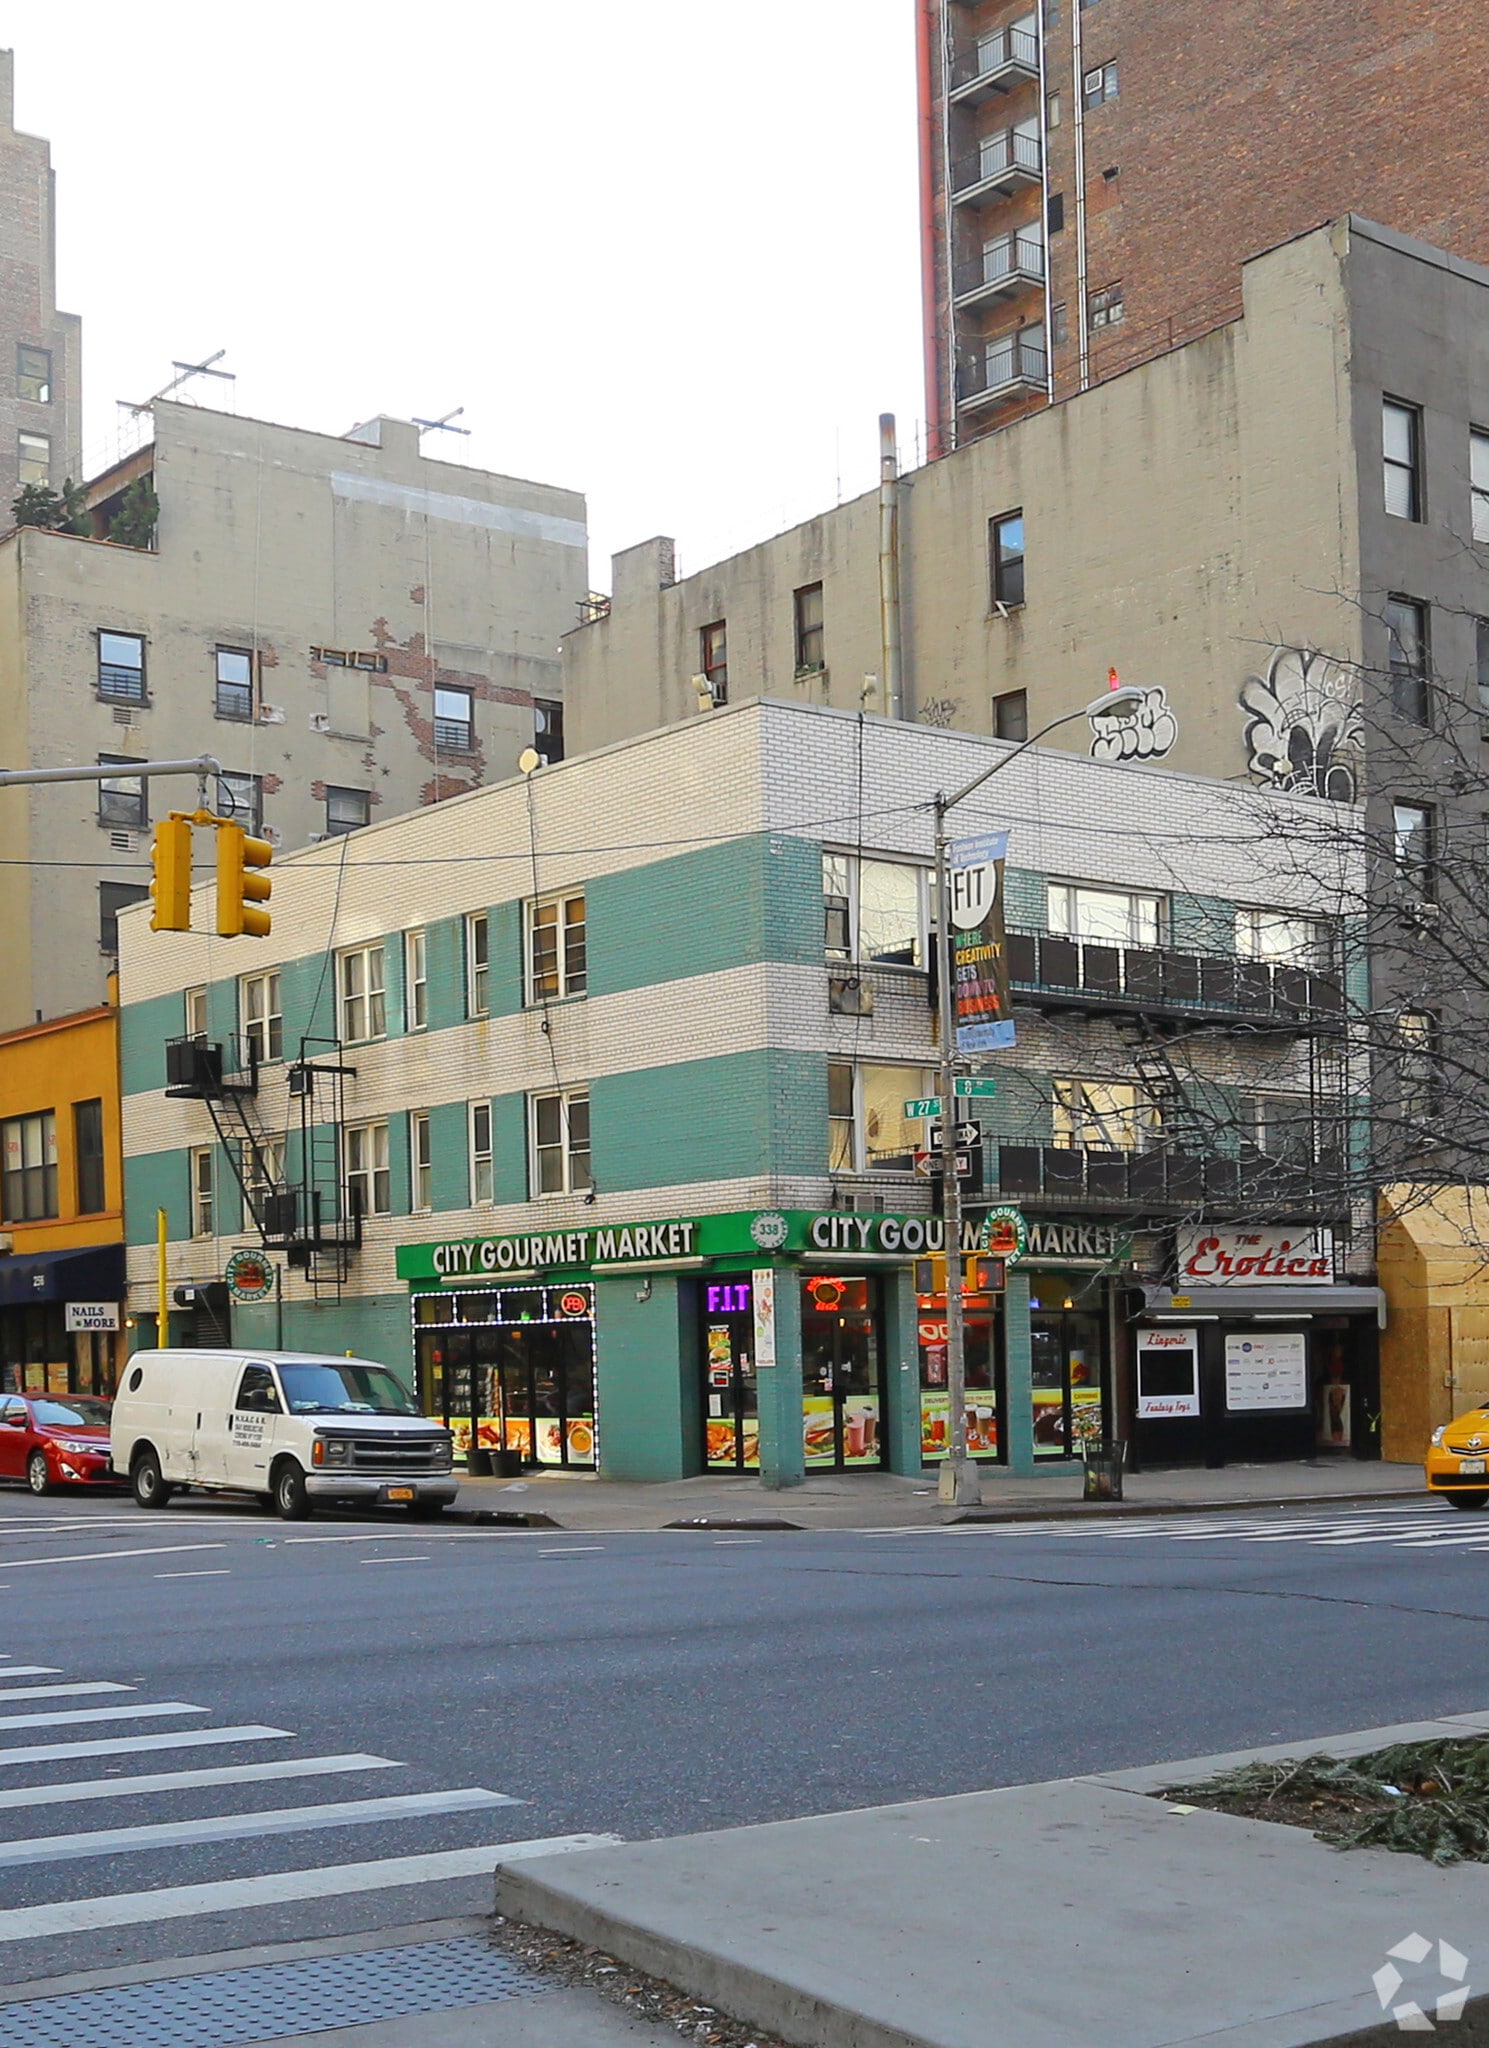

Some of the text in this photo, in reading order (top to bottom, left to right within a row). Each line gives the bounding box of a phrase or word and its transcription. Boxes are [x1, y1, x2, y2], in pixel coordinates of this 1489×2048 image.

[953, 866, 985, 911] FIT
[956, 930, 982, 948] WHERE
[955, 943, 1001, 966] CREATIVITY
[956, 965, 978, 982] GETS
[957, 994, 1000, 1016] BUSINESS
[906, 1103, 915, 1117] W
[918, 1100, 931, 1116] 27
[922, 1160, 939, 1171] ONE
[759, 1224, 779, 1236] 338
[811, 1216, 873, 1249] CITY
[432, 1222, 694, 1274] CITY GOURMET MARKET
[1235, 1234, 1263, 1246] THE
[1186, 1236, 1332, 1277] Erotica
[72, 1306, 104, 1317] NAILS
[83, 1318, 116, 1328] MORE
